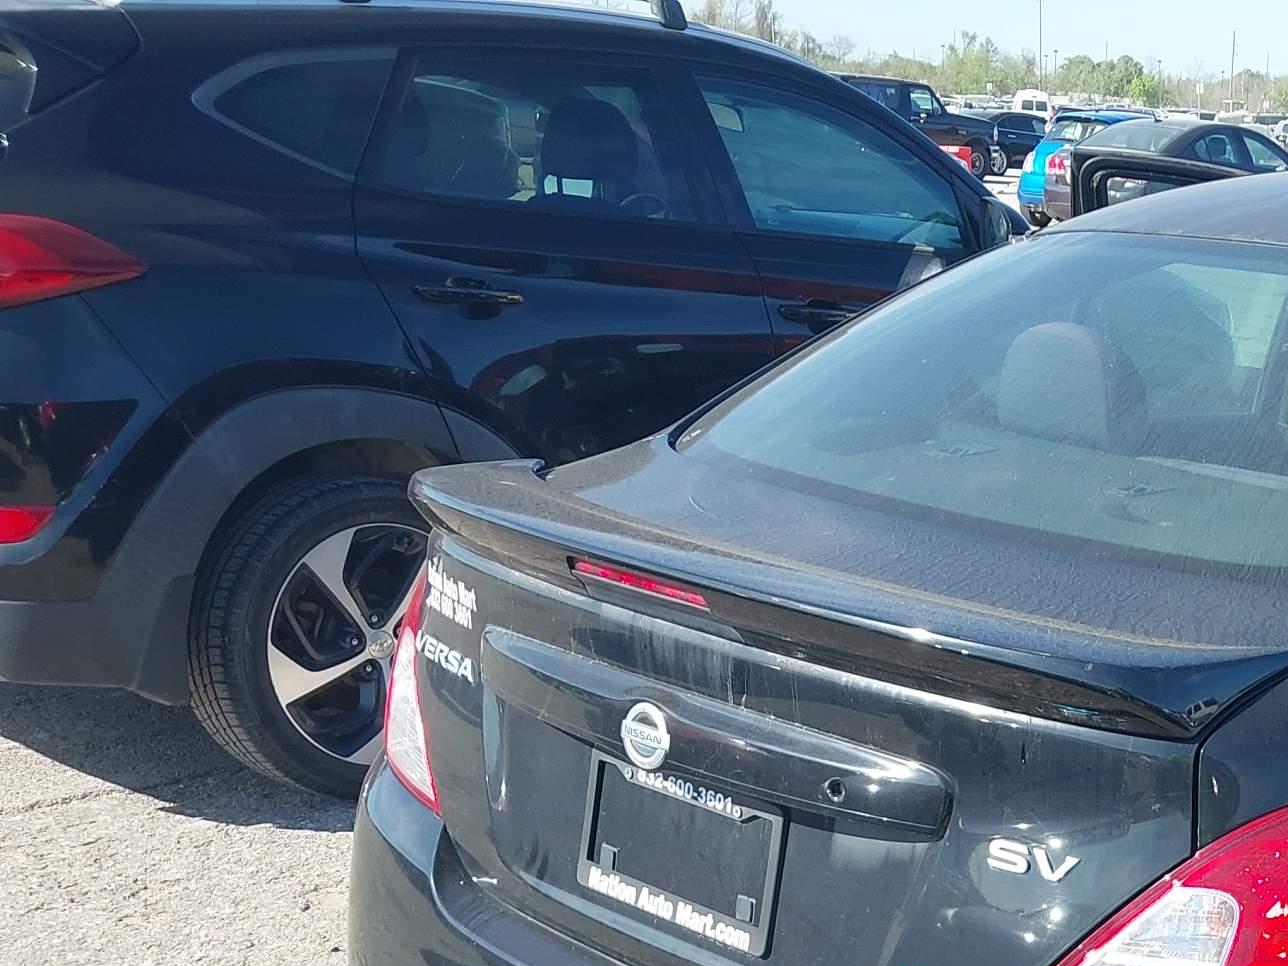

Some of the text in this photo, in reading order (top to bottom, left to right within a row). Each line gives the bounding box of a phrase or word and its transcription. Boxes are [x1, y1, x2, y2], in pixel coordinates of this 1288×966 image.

[416, 630, 475, 685] VERSA
[624, 724, 663, 745] NISSAN
[637, 769, 733, 814] 832-600-3601
[987, 838, 1082, 882] SV
[588, 866, 751, 951] Nation Auto Mart.com
